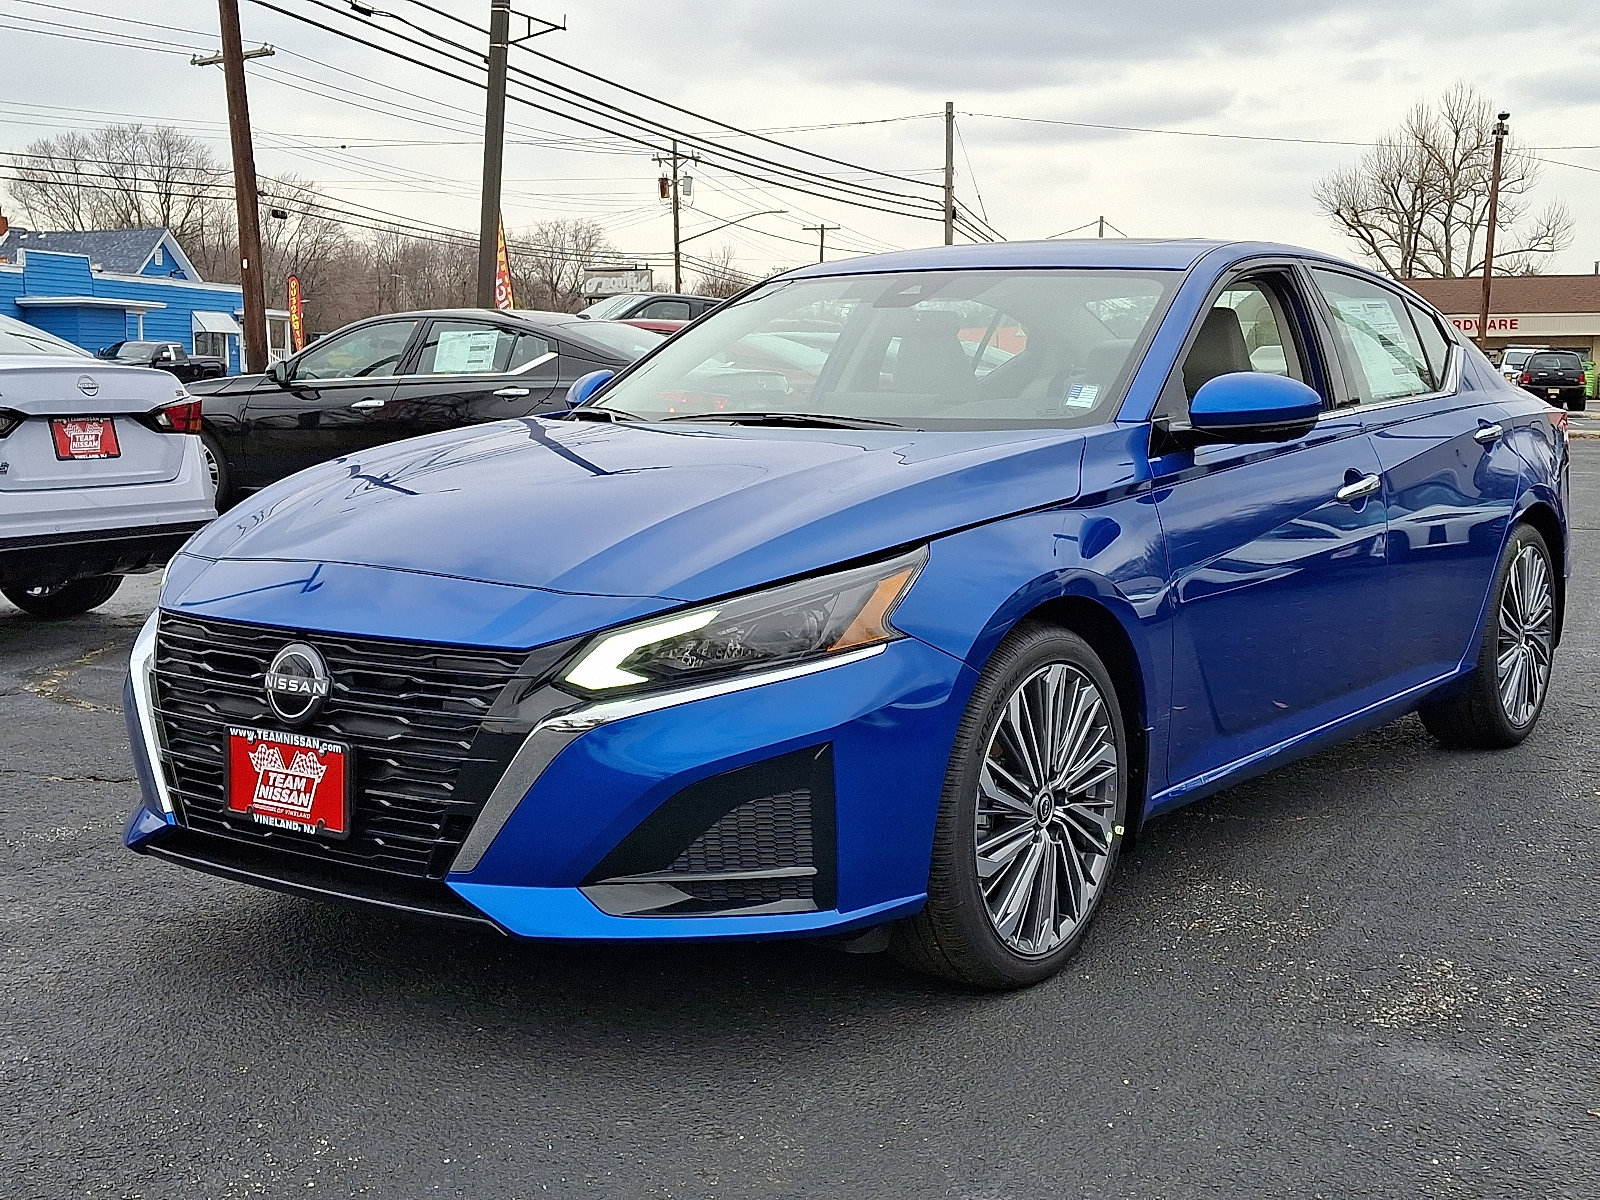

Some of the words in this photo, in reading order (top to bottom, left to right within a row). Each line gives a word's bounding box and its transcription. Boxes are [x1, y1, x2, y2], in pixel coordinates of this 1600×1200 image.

[72, 441, 99, 449] NISSAN
[75, 434, 96, 442] TEAM
[264, 673, 328, 695] NISSAN
[268, 771, 307, 792] TEAM
[258, 784, 310, 807] NISSAN
[253, 813, 301, 832] VINELAND,
[303, 824, 316, 835] NJ
